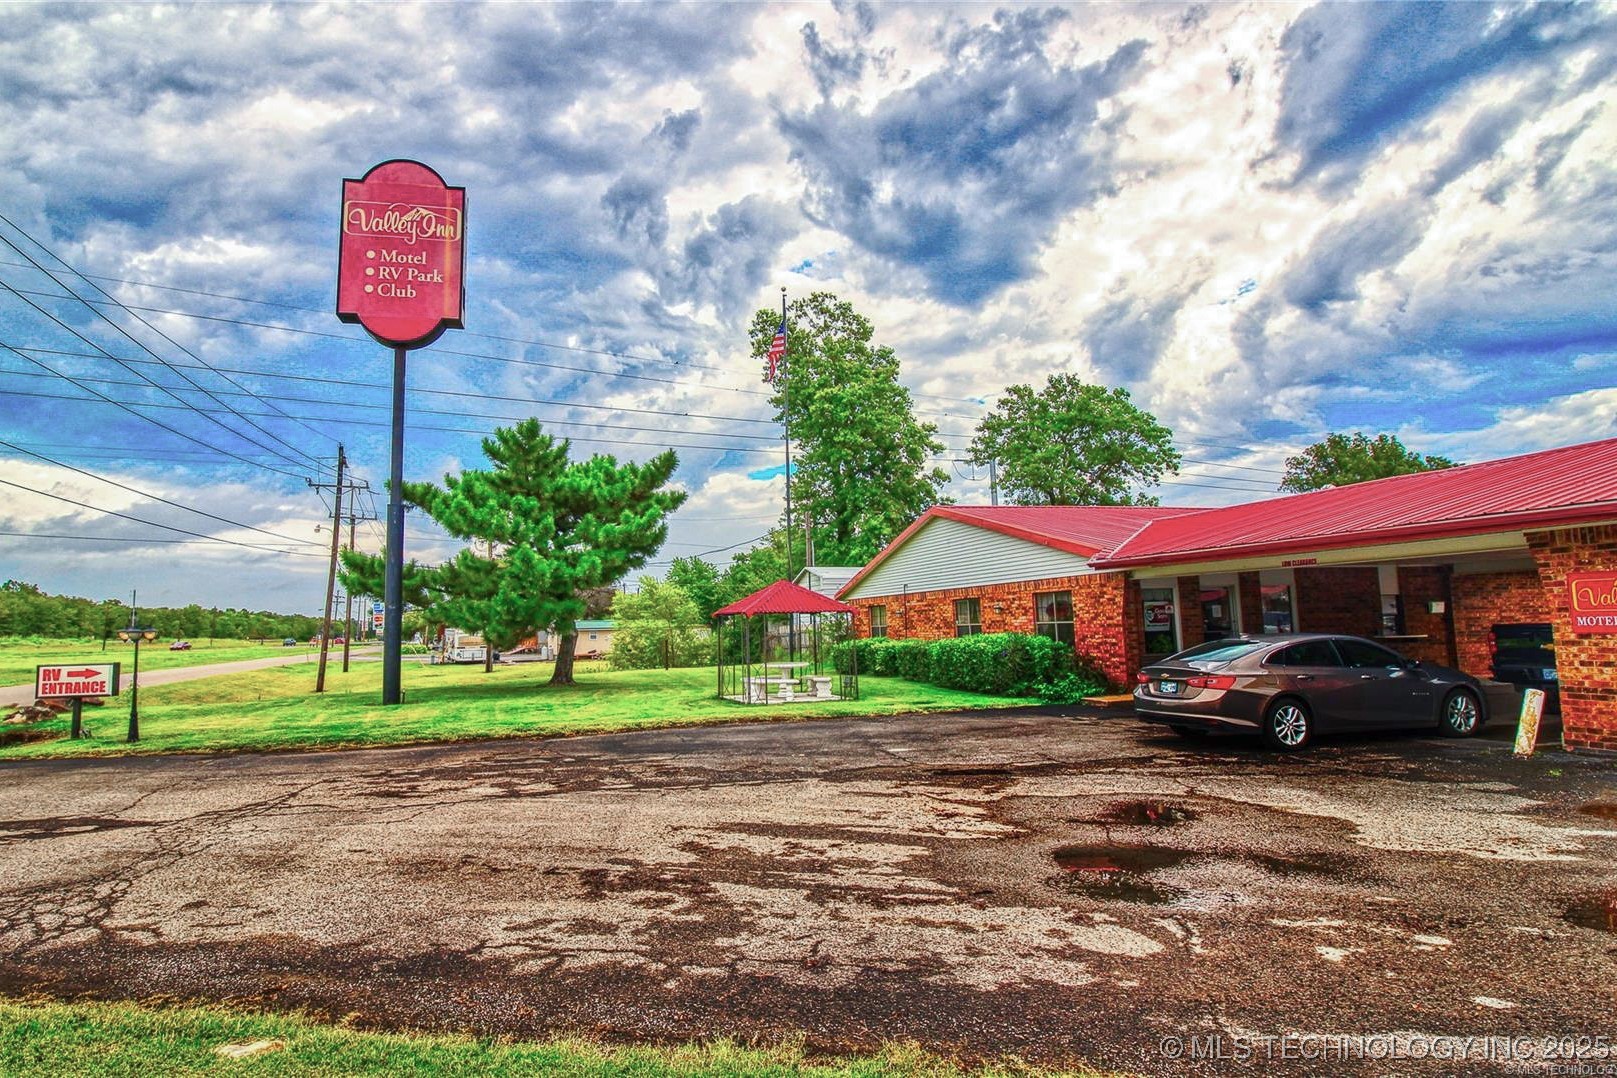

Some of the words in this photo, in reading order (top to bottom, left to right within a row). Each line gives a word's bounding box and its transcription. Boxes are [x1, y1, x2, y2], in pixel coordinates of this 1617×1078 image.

[349, 207, 417, 244] Valley
[417, 213, 455, 238] Inn
[380, 250, 427, 264] Motel
[378, 267, 404, 280] RV
[407, 268, 443, 283] Park
[377, 283, 417, 298] Club
[42, 668, 62, 682] RV
[41, 681, 106, 695] ENTRANCE
